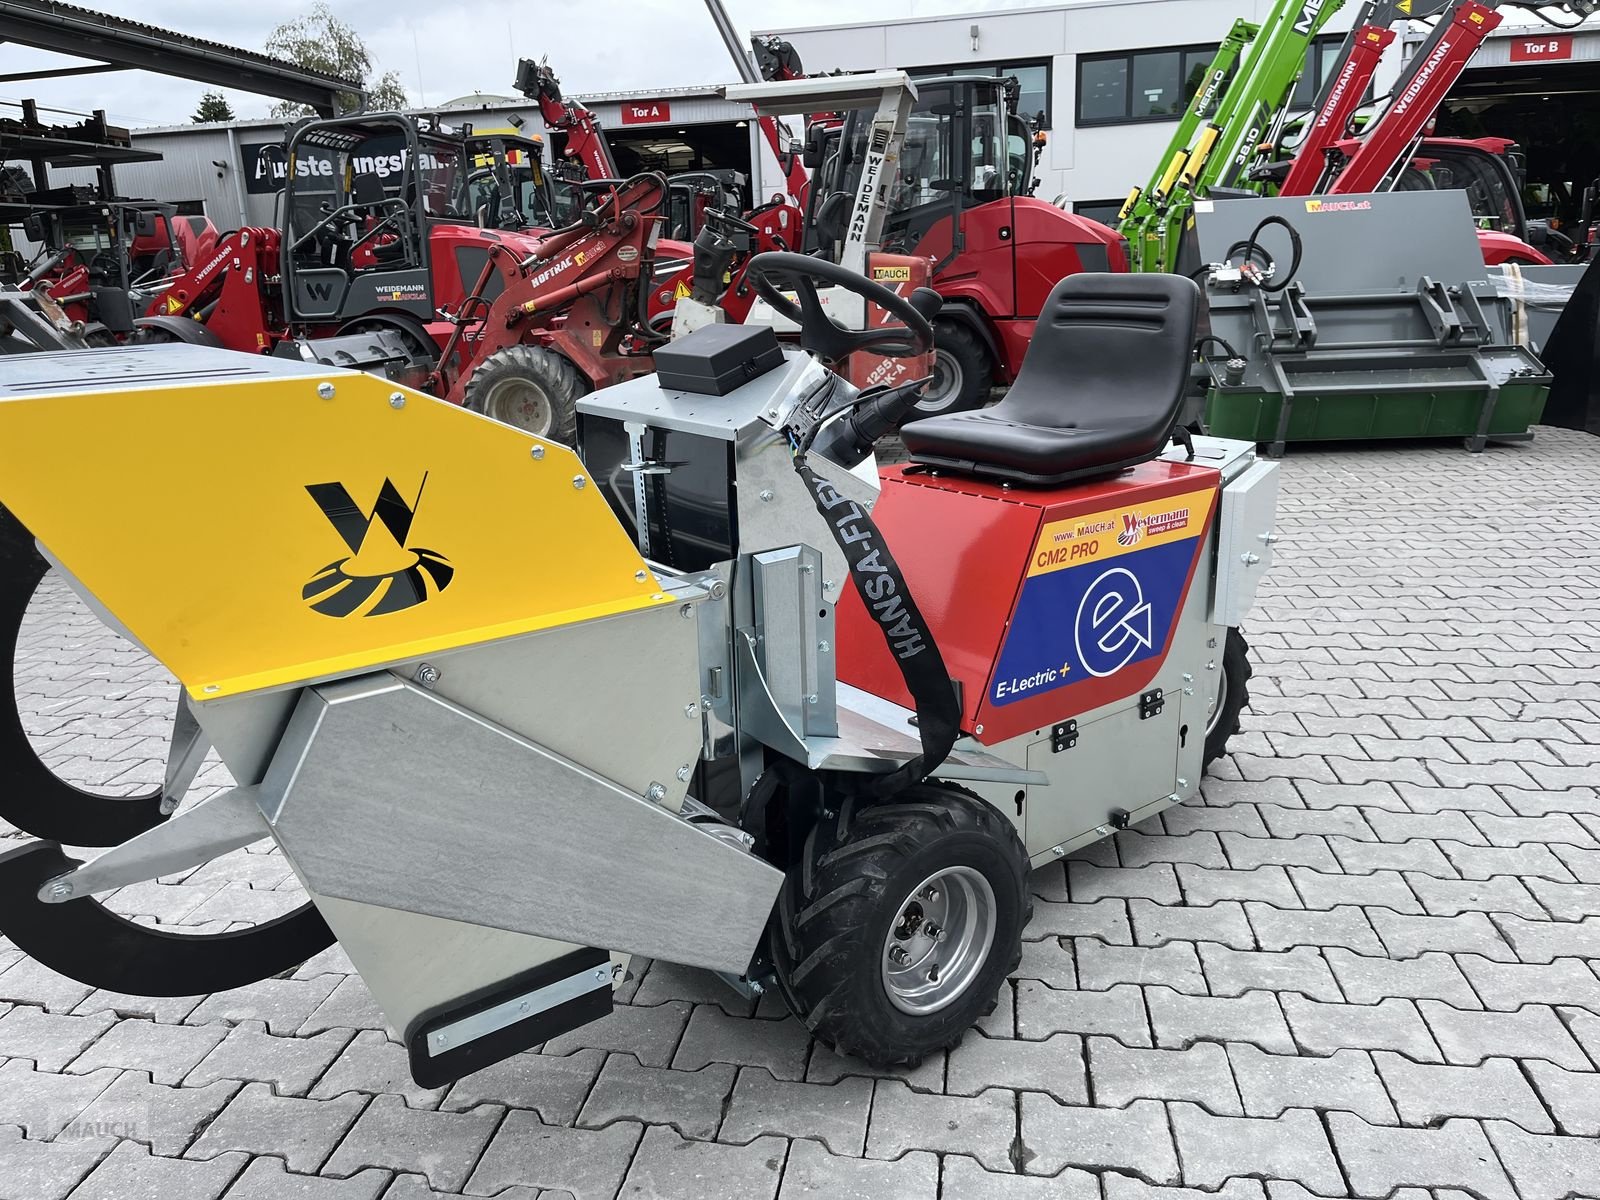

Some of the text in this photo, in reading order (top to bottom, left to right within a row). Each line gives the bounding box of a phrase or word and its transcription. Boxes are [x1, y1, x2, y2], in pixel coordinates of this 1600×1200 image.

[1525, 41, 1559, 54] Tor B
[1194, 69, 1225, 117] MERLO
[1394, 41, 1451, 114] WEIDEMANN
[1317, 61, 1357, 127] WEIDEMANN
[632, 106, 660, 118] Tor A
[1235, 127, 1260, 166] 38.10
[849, 155, 883, 242] WEIDEMANN
[196, 245, 233, 282] WEIDEMANN
[531, 254, 573, 289] HOFTRAC
[874, 268, 909, 280] MAUCH
[375, 284, 425, 293] WEIDEMANN
[1122, 508, 1189, 535] Westermann
[1148, 525, 1166, 535] sweep
[1037, 540, 1099, 568] CM2 PRO
[996, 668, 1057, 699] E-Lectric
